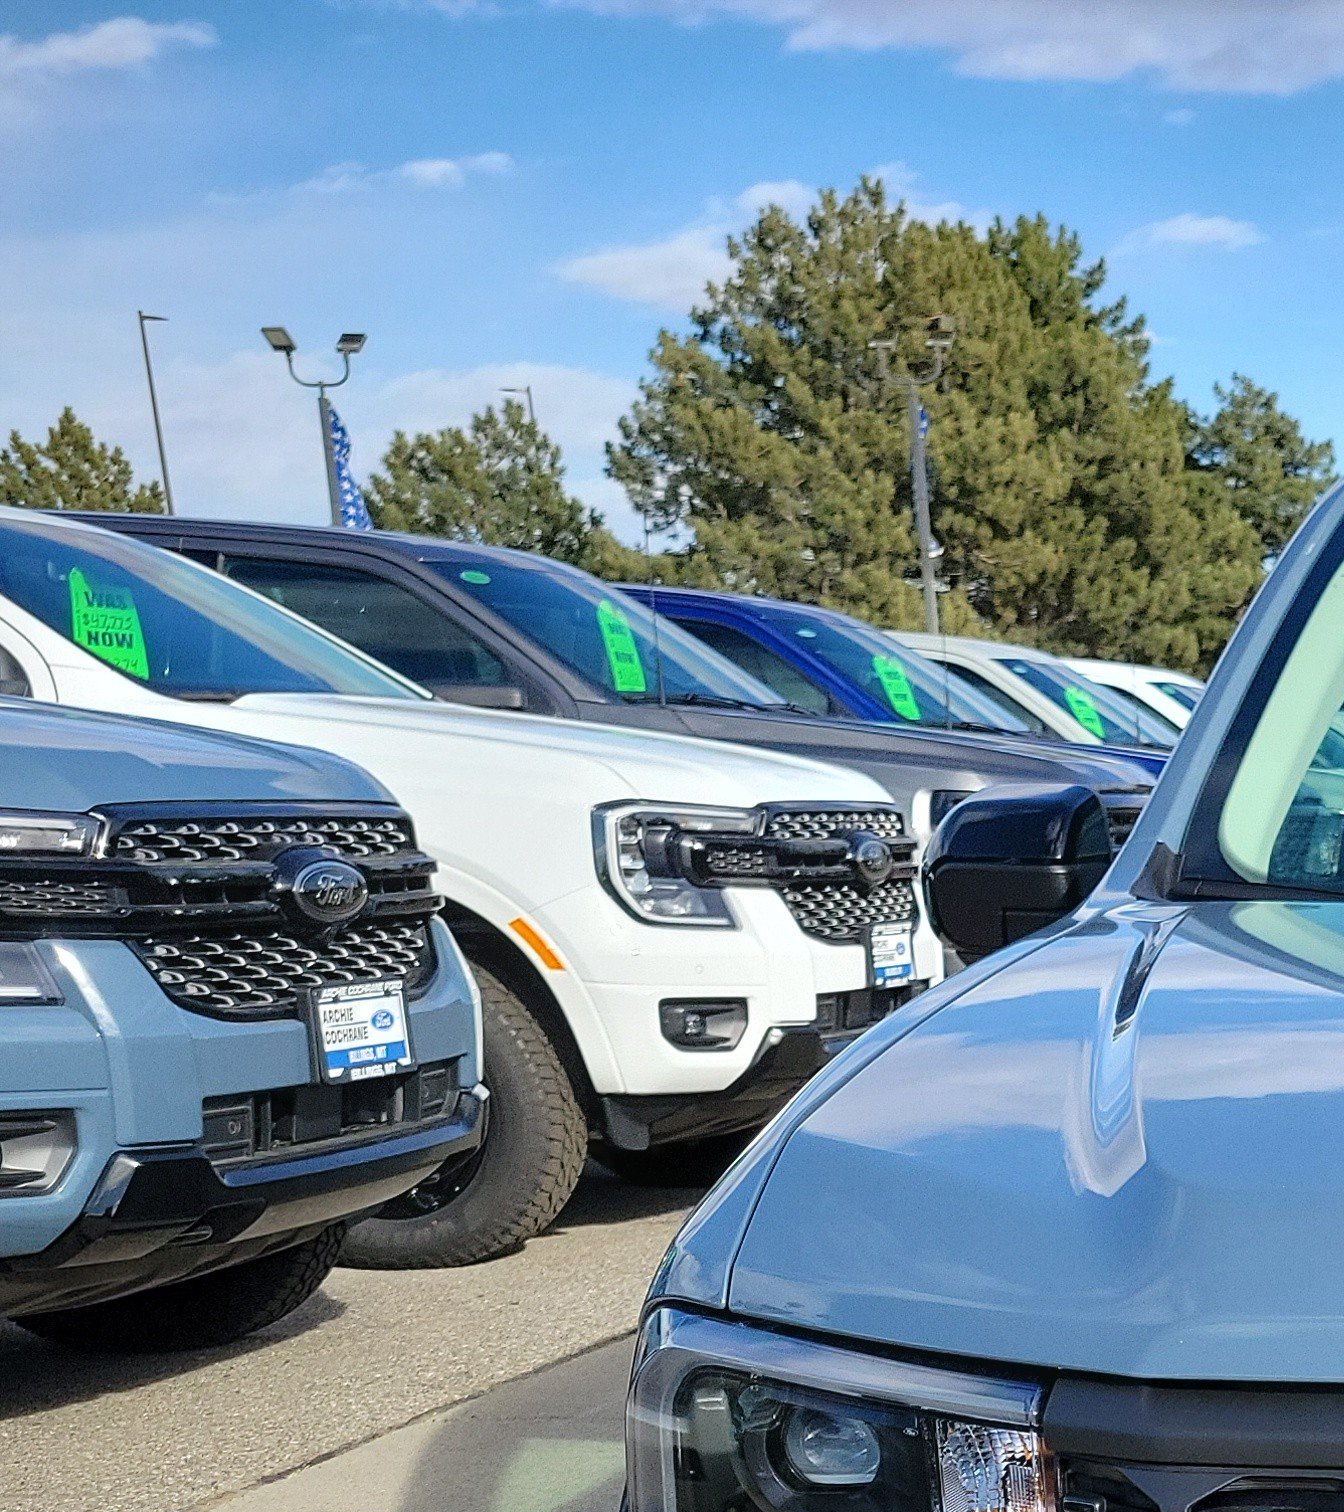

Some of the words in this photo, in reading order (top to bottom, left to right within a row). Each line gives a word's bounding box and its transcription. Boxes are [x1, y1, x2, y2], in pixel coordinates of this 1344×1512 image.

[86, 631, 134, 649] NOW
[315, 874, 356, 906] Ford
[322, 1007, 354, 1024] ARCHIE
[324, 1026, 369, 1045] COCHRANE
